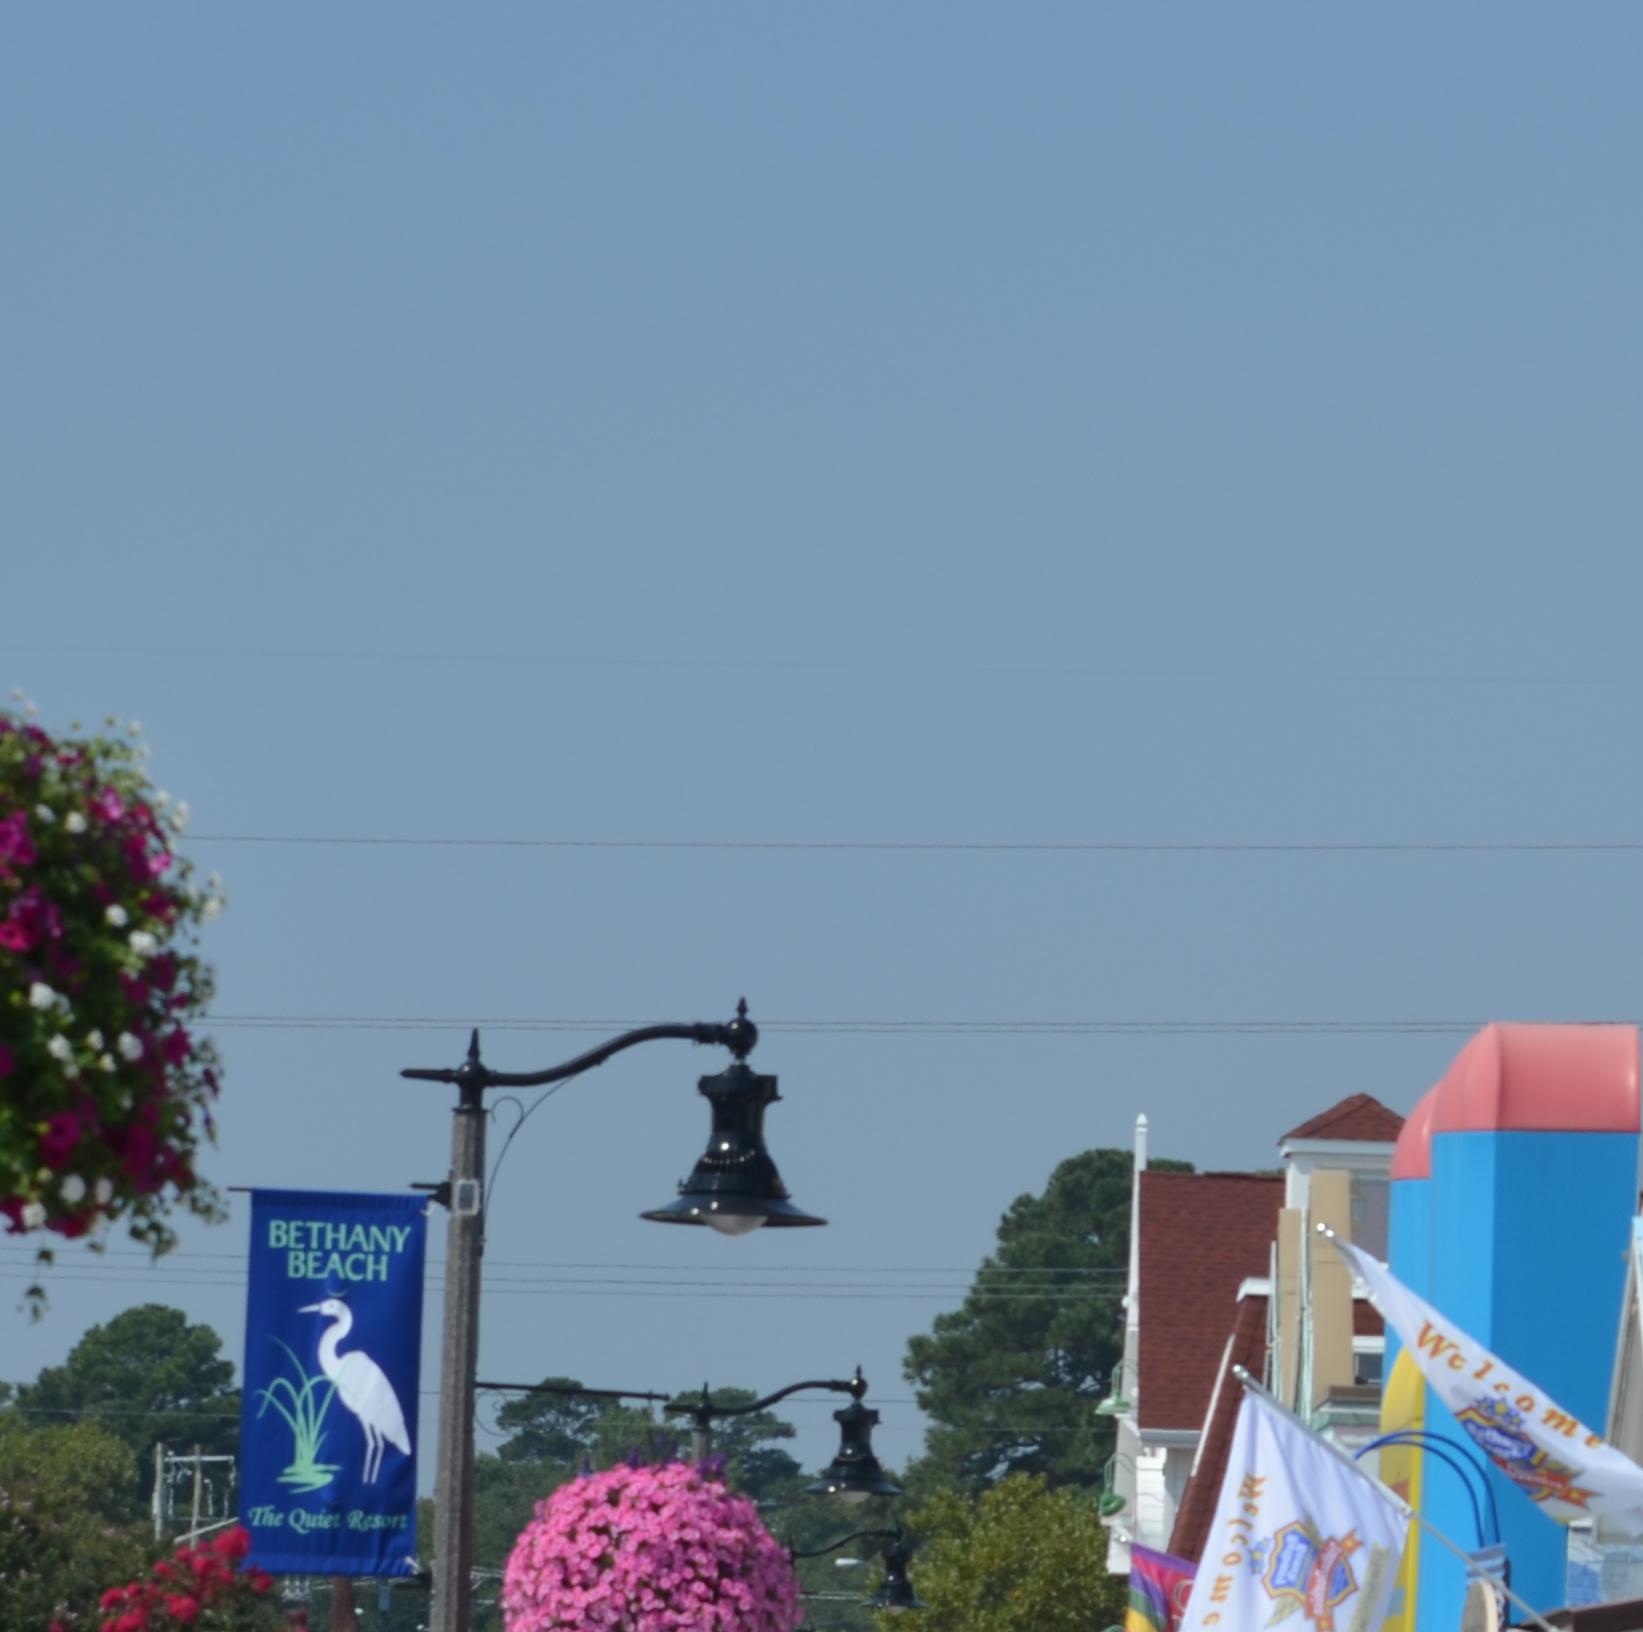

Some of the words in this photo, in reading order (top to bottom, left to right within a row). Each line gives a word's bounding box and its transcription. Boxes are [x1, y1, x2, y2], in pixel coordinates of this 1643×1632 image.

[269, 1220, 410, 1254] BETHANY
[287, 1252, 388, 1281] BEACH
[248, 1506, 288, 1529] The
[289, 1508, 341, 1534] Quiet
[347, 1510, 408, 1531] Resort
